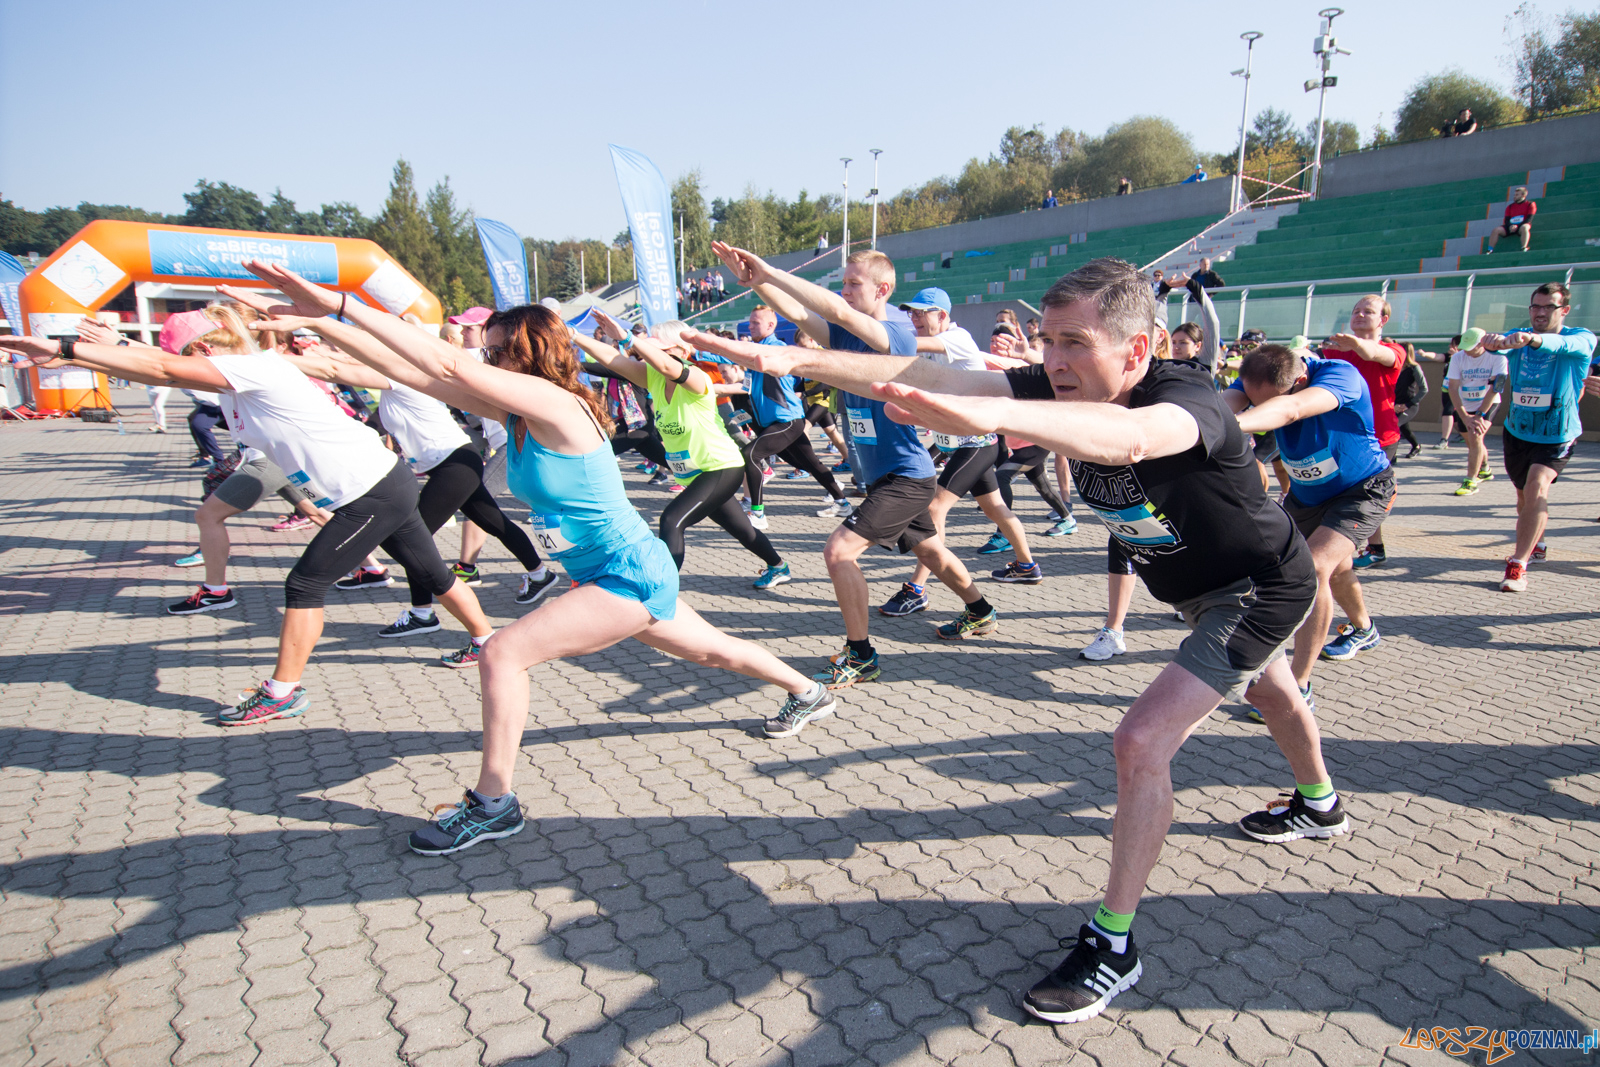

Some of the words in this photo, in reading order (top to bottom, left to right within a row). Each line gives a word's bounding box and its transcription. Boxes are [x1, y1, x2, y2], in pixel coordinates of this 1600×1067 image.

[206, 240, 288, 259] zaBIEGaj
[208, 254, 218, 263] o
[1520, 395, 1540, 404] 677
[936, 434, 950, 445] 115
[1292, 466, 1322, 479] 563
